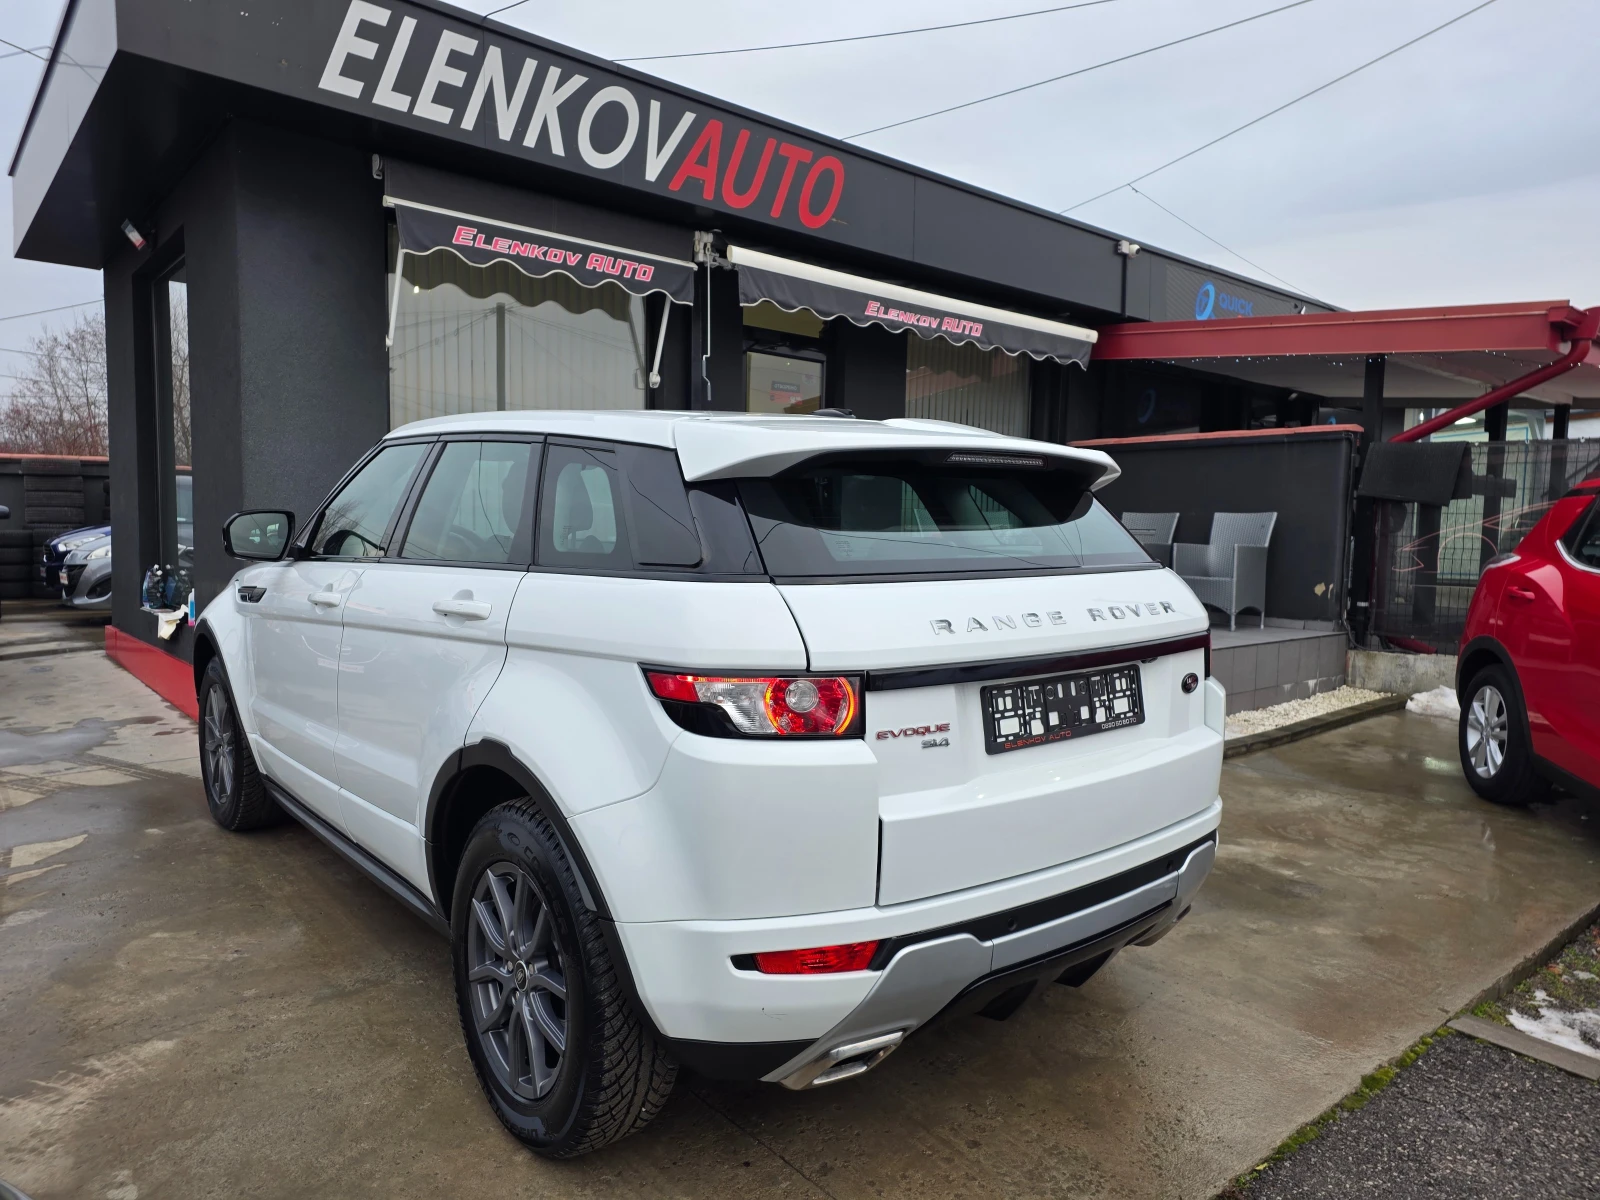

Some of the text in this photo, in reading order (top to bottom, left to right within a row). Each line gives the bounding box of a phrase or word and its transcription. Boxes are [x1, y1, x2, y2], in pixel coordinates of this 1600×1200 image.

[452, 225, 655, 282] ELENKOV AUTO
[1219, 292, 1253, 316] QUICK
[865, 301, 983, 337] ELENKOV AUTO
[930, 600, 1176, 635] RANGE ROVER
[876, 723, 950, 740] EVOQUE
[1049, 730, 1072, 741] AUTO
